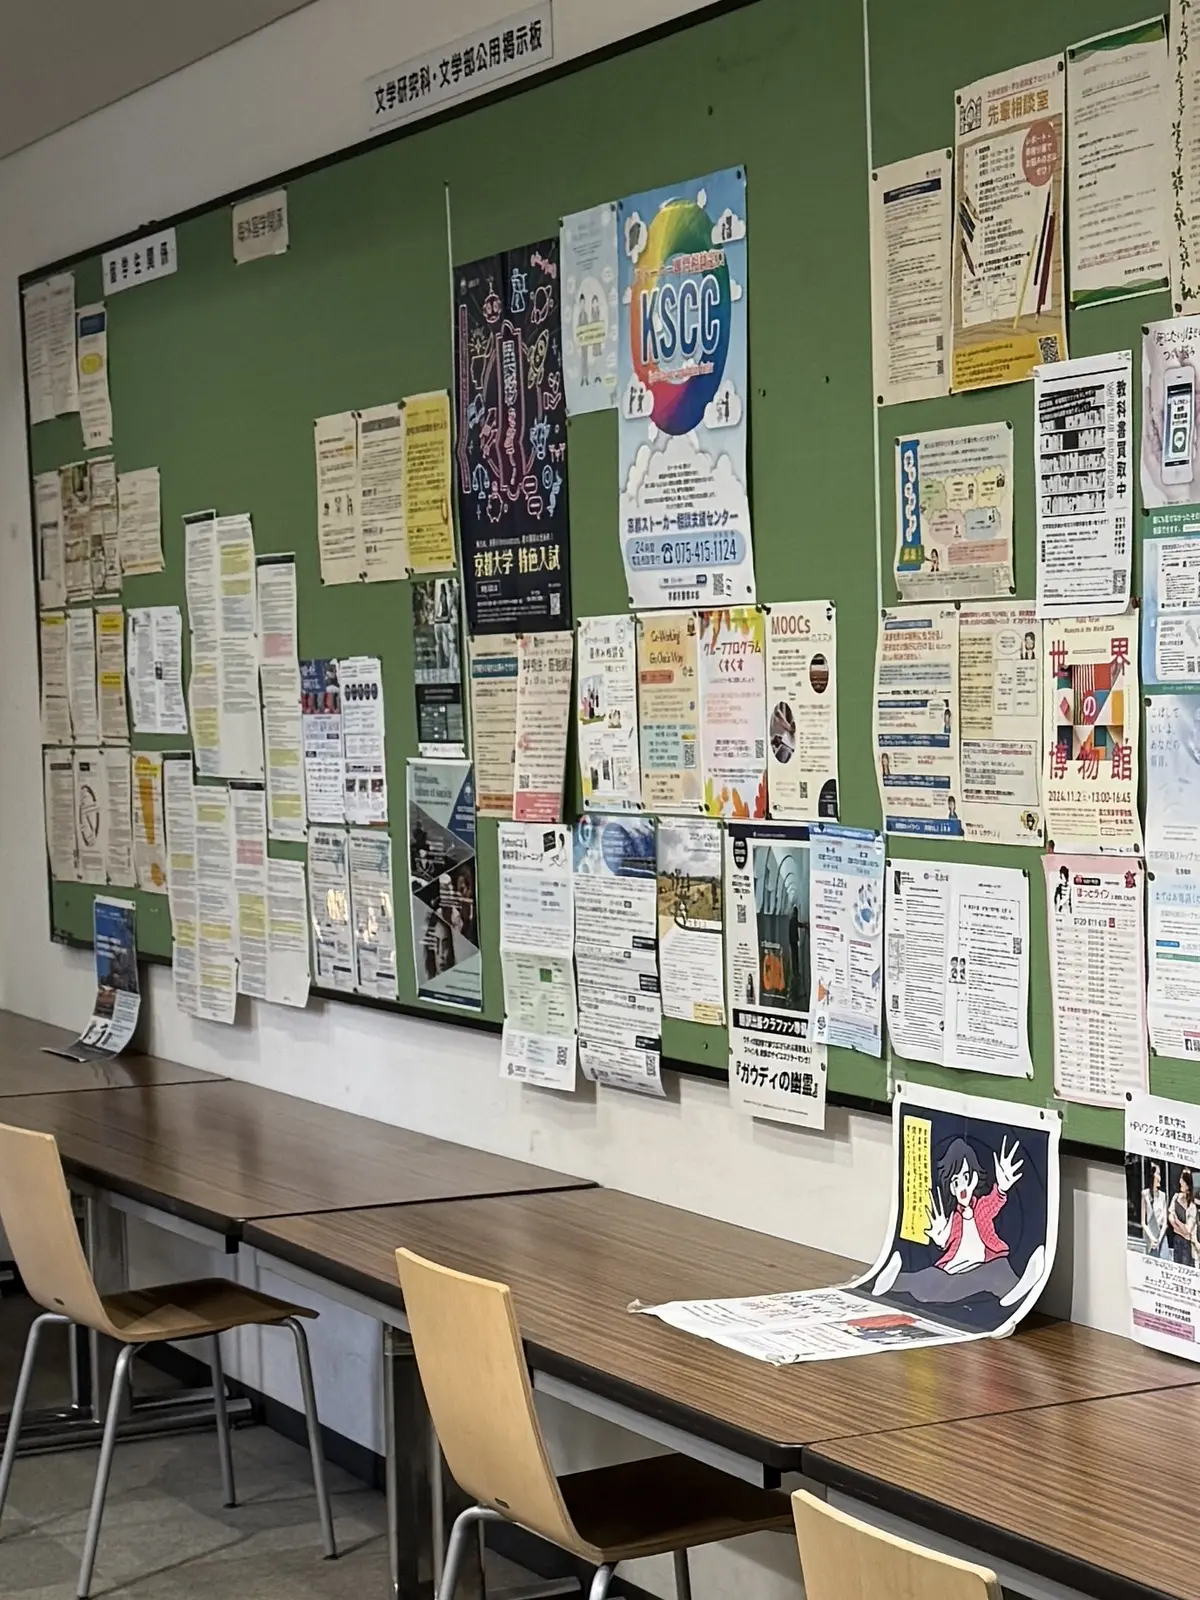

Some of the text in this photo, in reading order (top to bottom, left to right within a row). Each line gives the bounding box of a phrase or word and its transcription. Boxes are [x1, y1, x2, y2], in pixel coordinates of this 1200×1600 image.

[374, 19, 542, 114] 文学研究科・文学部公用掲示板
[988, 89, 1049, 126] 先輩相談室
[640, 274, 720, 366] KSCC
[627, 509, 739, 534] 京都ストーカー相談支援センター
[473, 544, 561, 577] 京都大学 特色入試
[674, 538, 737, 564] 075-415-1124
[771, 615, 811, 636] MOOCs
[718, 658, 744, 674] くすくす
[1049, 637, 1131, 678] 世界
[1083, 695, 1098, 717] の
[1049, 741, 1133, 781] 博物館
